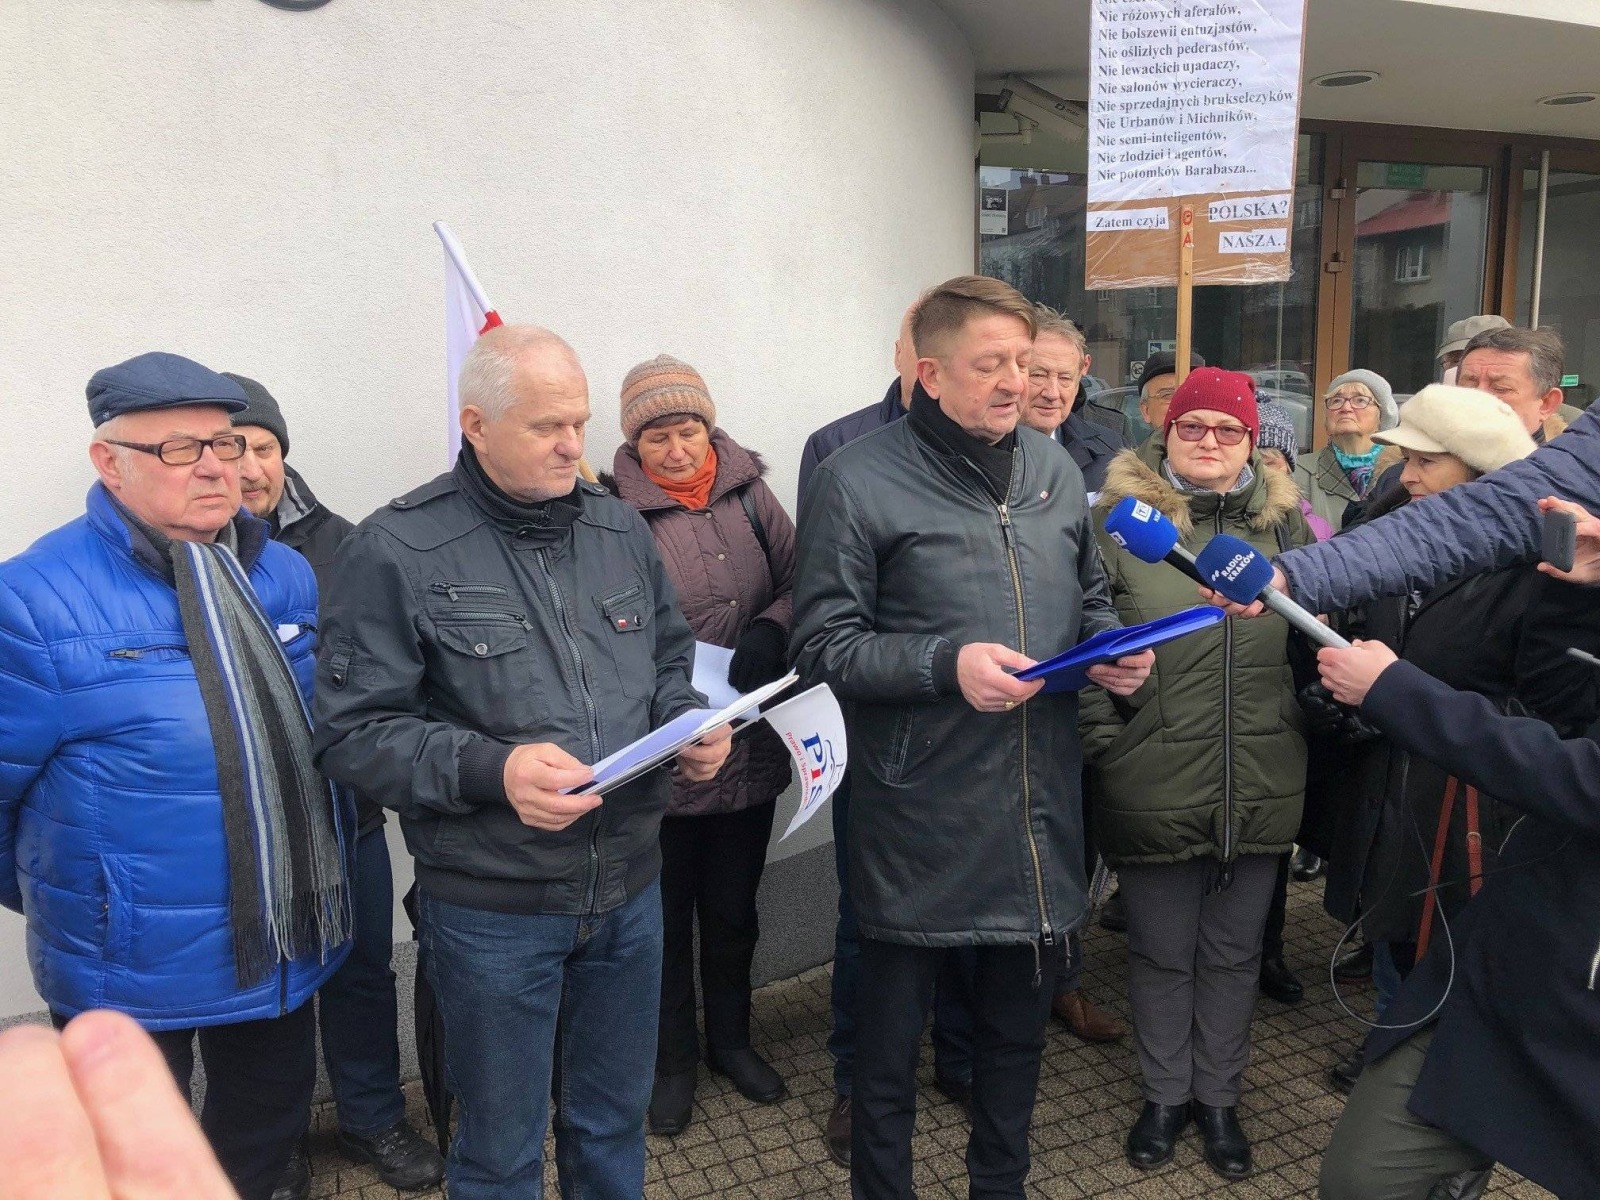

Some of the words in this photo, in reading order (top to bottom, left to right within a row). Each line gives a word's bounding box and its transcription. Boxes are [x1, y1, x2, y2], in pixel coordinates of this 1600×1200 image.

[1099, 10, 1118, 22] Nie
[1122, 8, 1180, 22] różowych
[1099, 29, 1118, 41] Nie
[1121, 25, 1177, 40] bolszewii
[1180, 21, 1257, 37] entuzjastów,
[1099, 47, 1118, 59] Nie
[1099, 65, 1118, 77] Nie
[1121, 61, 1180, 76] lewackich
[1182, 60, 1240, 74] ujadaczy,
[1098, 83, 1117, 95] Nie
[1120, 80, 1169, 93] salonów
[1097, 101, 1117, 113] Nie
[1119, 96, 1199, 113] sprzedajnych
[1203, 89, 1294, 106] brukselczyków
[1097, 118, 1116, 130] Nie
[1120, 114, 1174, 128] Urbanów
[1179, 113, 1184, 125] i
[1097, 135, 1116, 147] Nie
[1119, 129, 1227, 145] semi-inteligentów,
[1097, 152, 1116, 164] Nie
[1174, 147, 1227, 161] agentów,
[1097, 170, 1116, 181] Nie
[1120, 165, 1180, 183] potomków
[1185, 163, 1256, 177] Barabasza...
[1209, 200, 1288, 221] POLSKA?
[1095, 216, 1133, 229] Zatem
[1136, 215, 1166, 229] czyja
[1220, 554, 1243, 577] RADIO
[1227, 550, 1255, 582] KRAKÓW
[785, 731, 802, 756] Prawo
